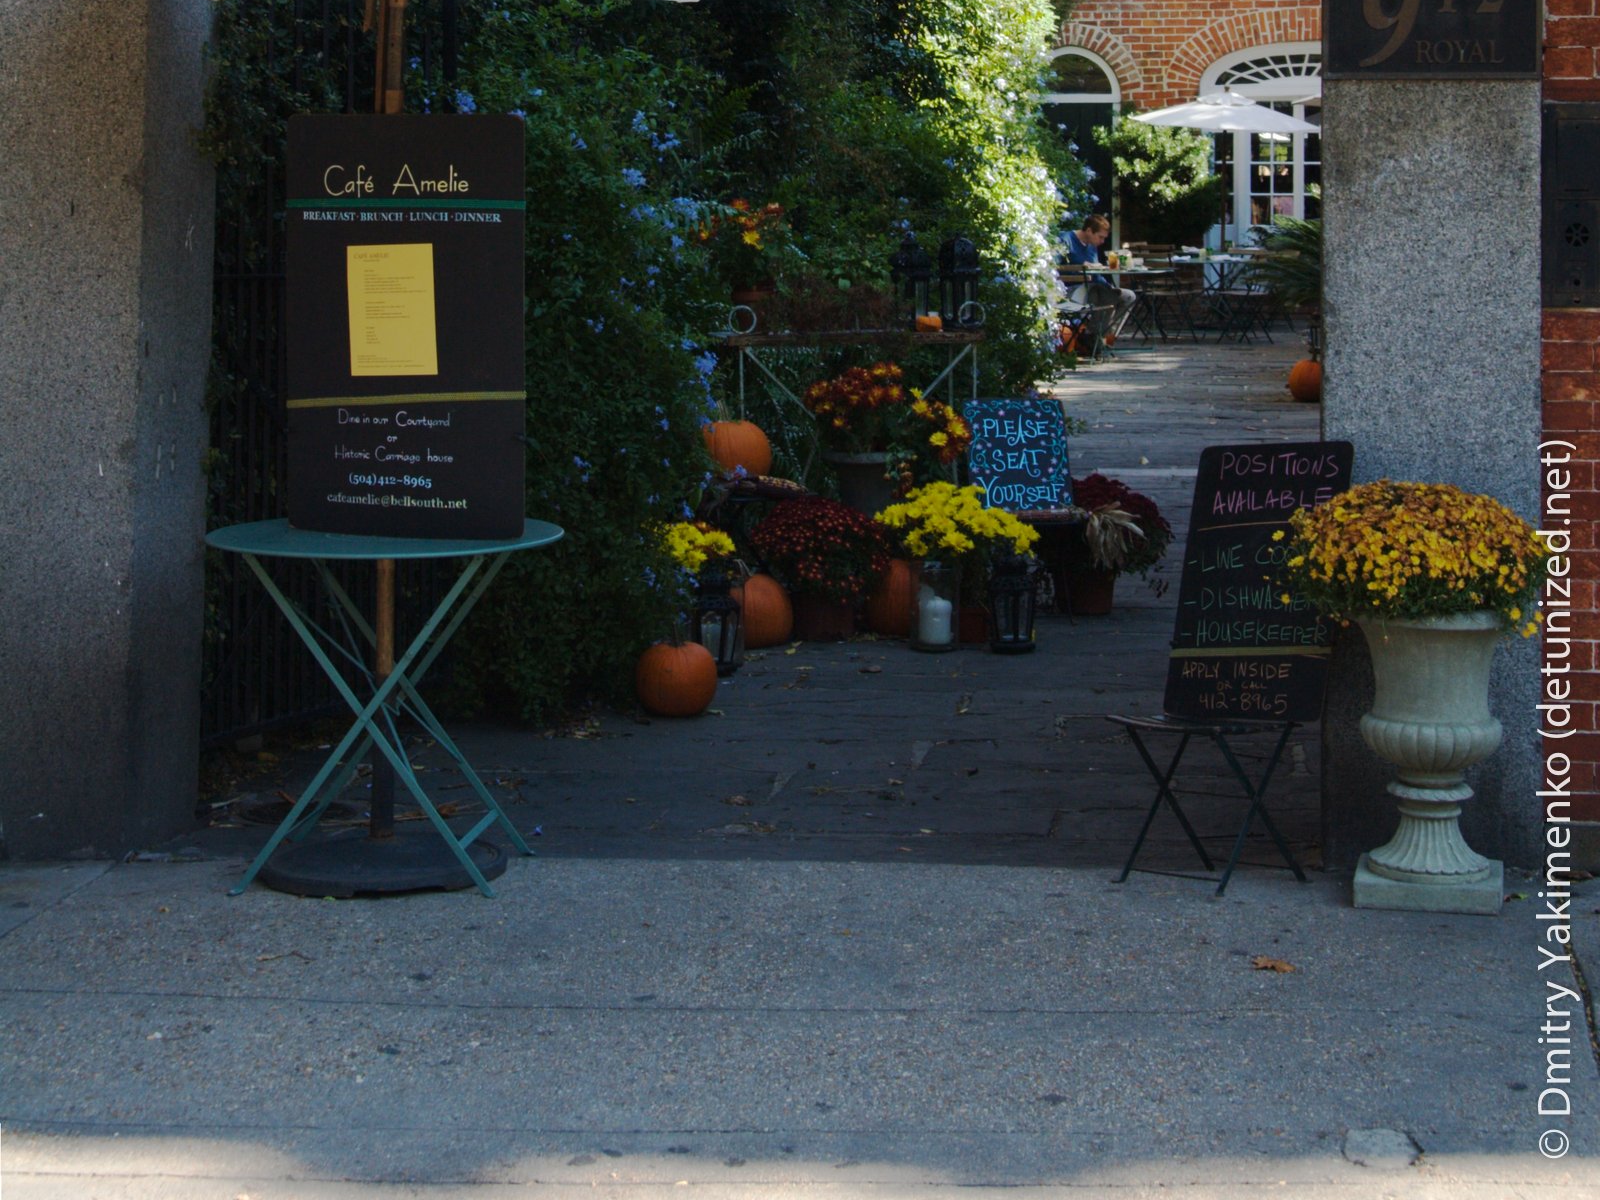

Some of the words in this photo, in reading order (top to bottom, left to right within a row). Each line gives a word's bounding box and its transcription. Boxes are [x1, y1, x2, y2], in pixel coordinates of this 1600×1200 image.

[1415, 39, 1505, 65] ROYAL
[323, 164, 375, 198] Café
[392, 163, 470, 196] Amelie
[303, 210, 356, 221] BREAKFAST
[359, 211, 403, 222] BRUNCH
[409, 212, 449, 222] LUNCH
[454, 212, 502, 223] DINNER
[337, 408, 360, 425] Dine
[362, 413, 371, 423] in
[372, 417, 389, 425] our
[395, 410, 451, 429] Courtyard
[982, 414, 1049, 446] PLEASE
[386, 434, 398, 443] or
[334, 444, 371, 460] Historic
[427, 447, 454, 463] house
[991, 448, 1047, 478] SEAT
[1219, 451, 1340, 481] POSITIONS
[326, 491, 468, 510] cafeamelie@bellsouth.net
[976, 476, 1065, 510] YOURSELF
[1211, 486, 1334, 516] AVAILABLE
[1181, 659, 1221, 680] APPLY
[1233, 660, 1293, 680] INSIDE
[1215, 680, 1233, 692] OR
[1240, 680, 1268, 690] CALL
[1199, 691, 1289, 715] 412-8965
